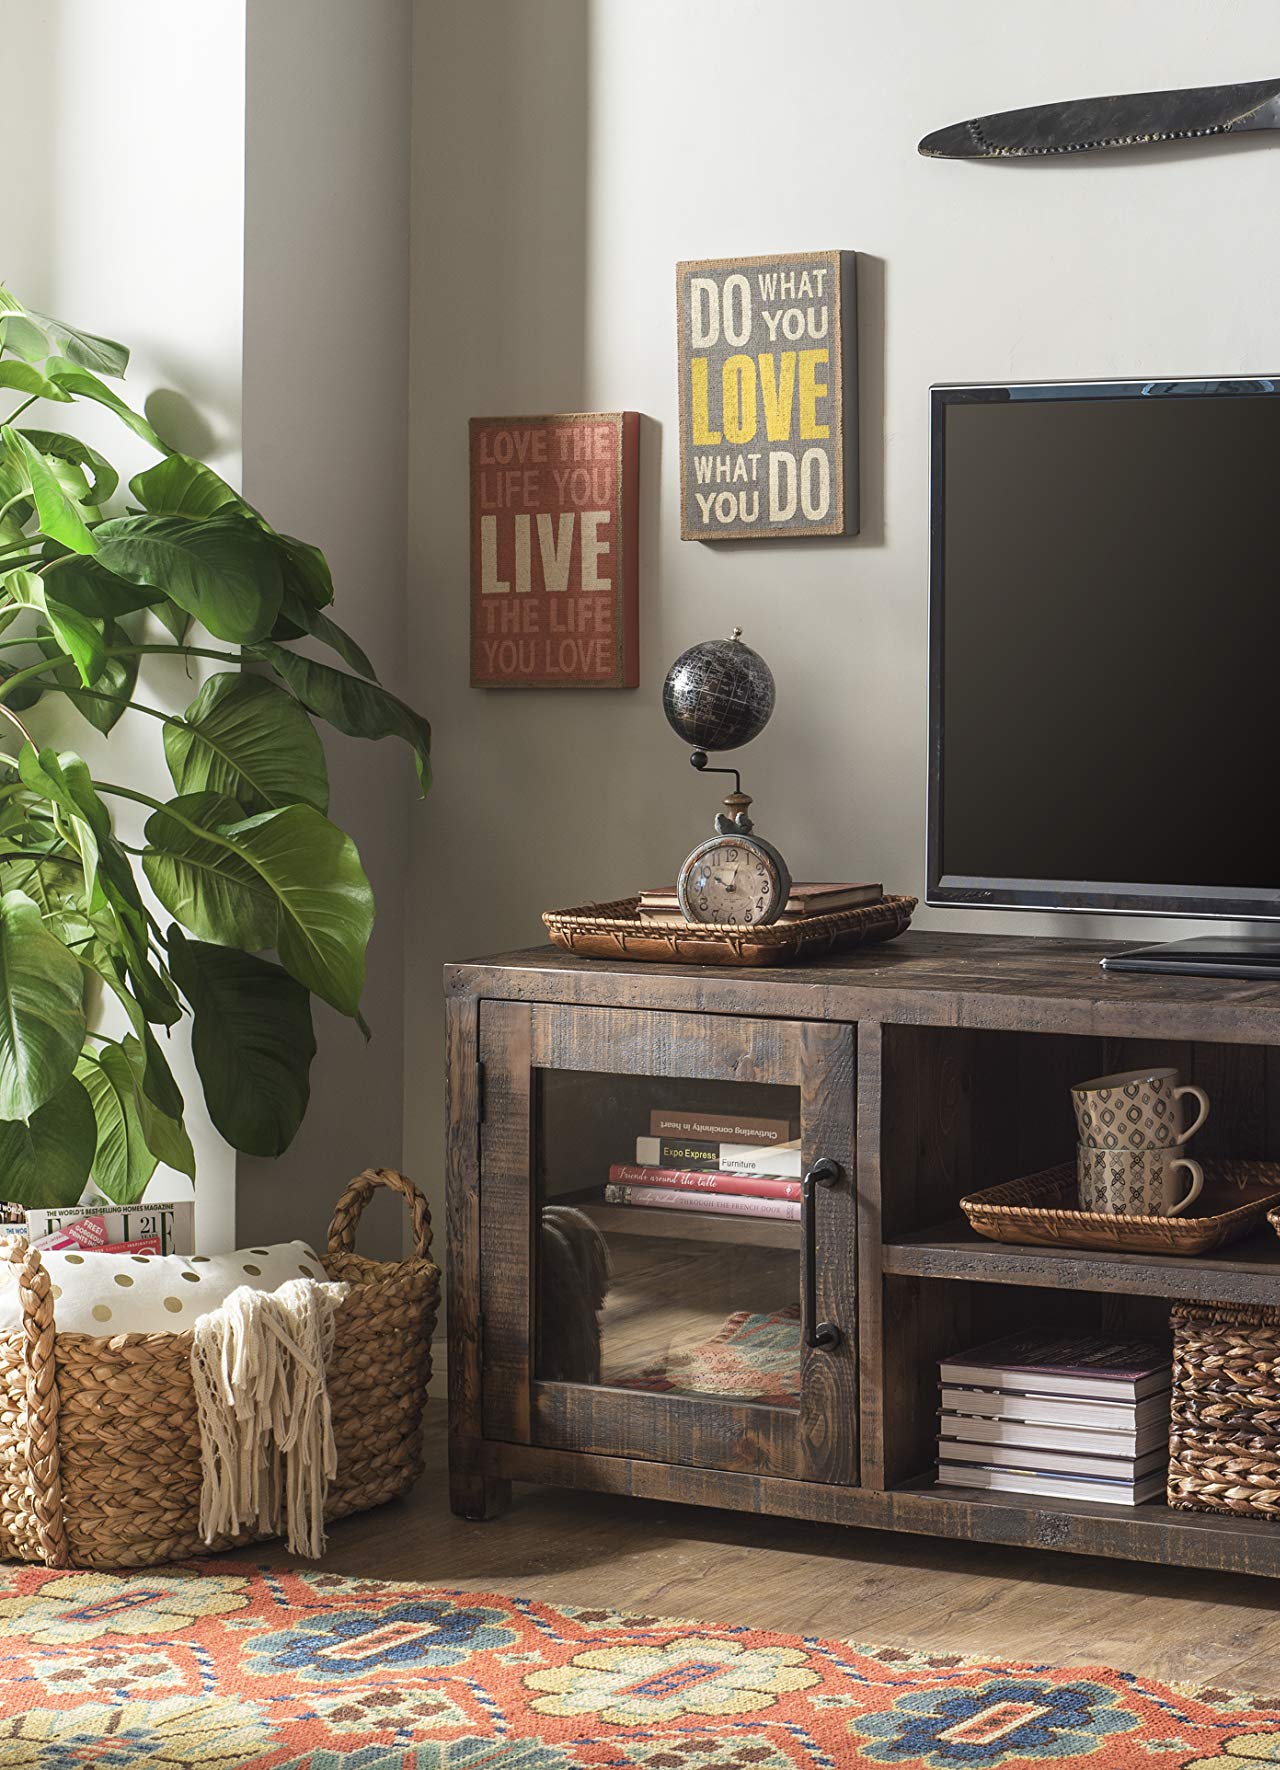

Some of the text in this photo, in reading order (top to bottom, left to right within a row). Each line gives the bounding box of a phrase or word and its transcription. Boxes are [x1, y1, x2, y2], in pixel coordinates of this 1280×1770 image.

[691, 269, 828, 349] DO WHAT
[762, 305, 828, 342] YOU
[691, 348, 830, 446] LOVE
[479, 427, 612, 465] LOVE THE
[480, 468, 612, 508] LIFE YOU
[694, 447, 831, 522] WHAT DO
[695, 490, 760, 524] YOU
[480, 510, 612, 594] LIVE
[482, 597, 612, 634] THE LIFE
[482, 638, 612, 674] YOU LOVE
[712, 853, 721, 867] 11
[725, 848, 739, 863] 12
[755, 862, 766, 877] 2
[761, 880, 770, 894] 3
[699, 897, 709, 911] 8
[755, 896, 764, 912] 4
[744, 908, 753, 923] 5
[660, 1120, 682, 1130] heart
[663, 1147, 717, 1161] Expo Express
[721, 1158, 756, 1169] Furniture
[681, 1172, 695, 1185] the
[122, 1204, 144, 1213] HOMES
[144, 1203, 174, 1212] MAGAZINE
[140, 1216, 157, 1234] 21
